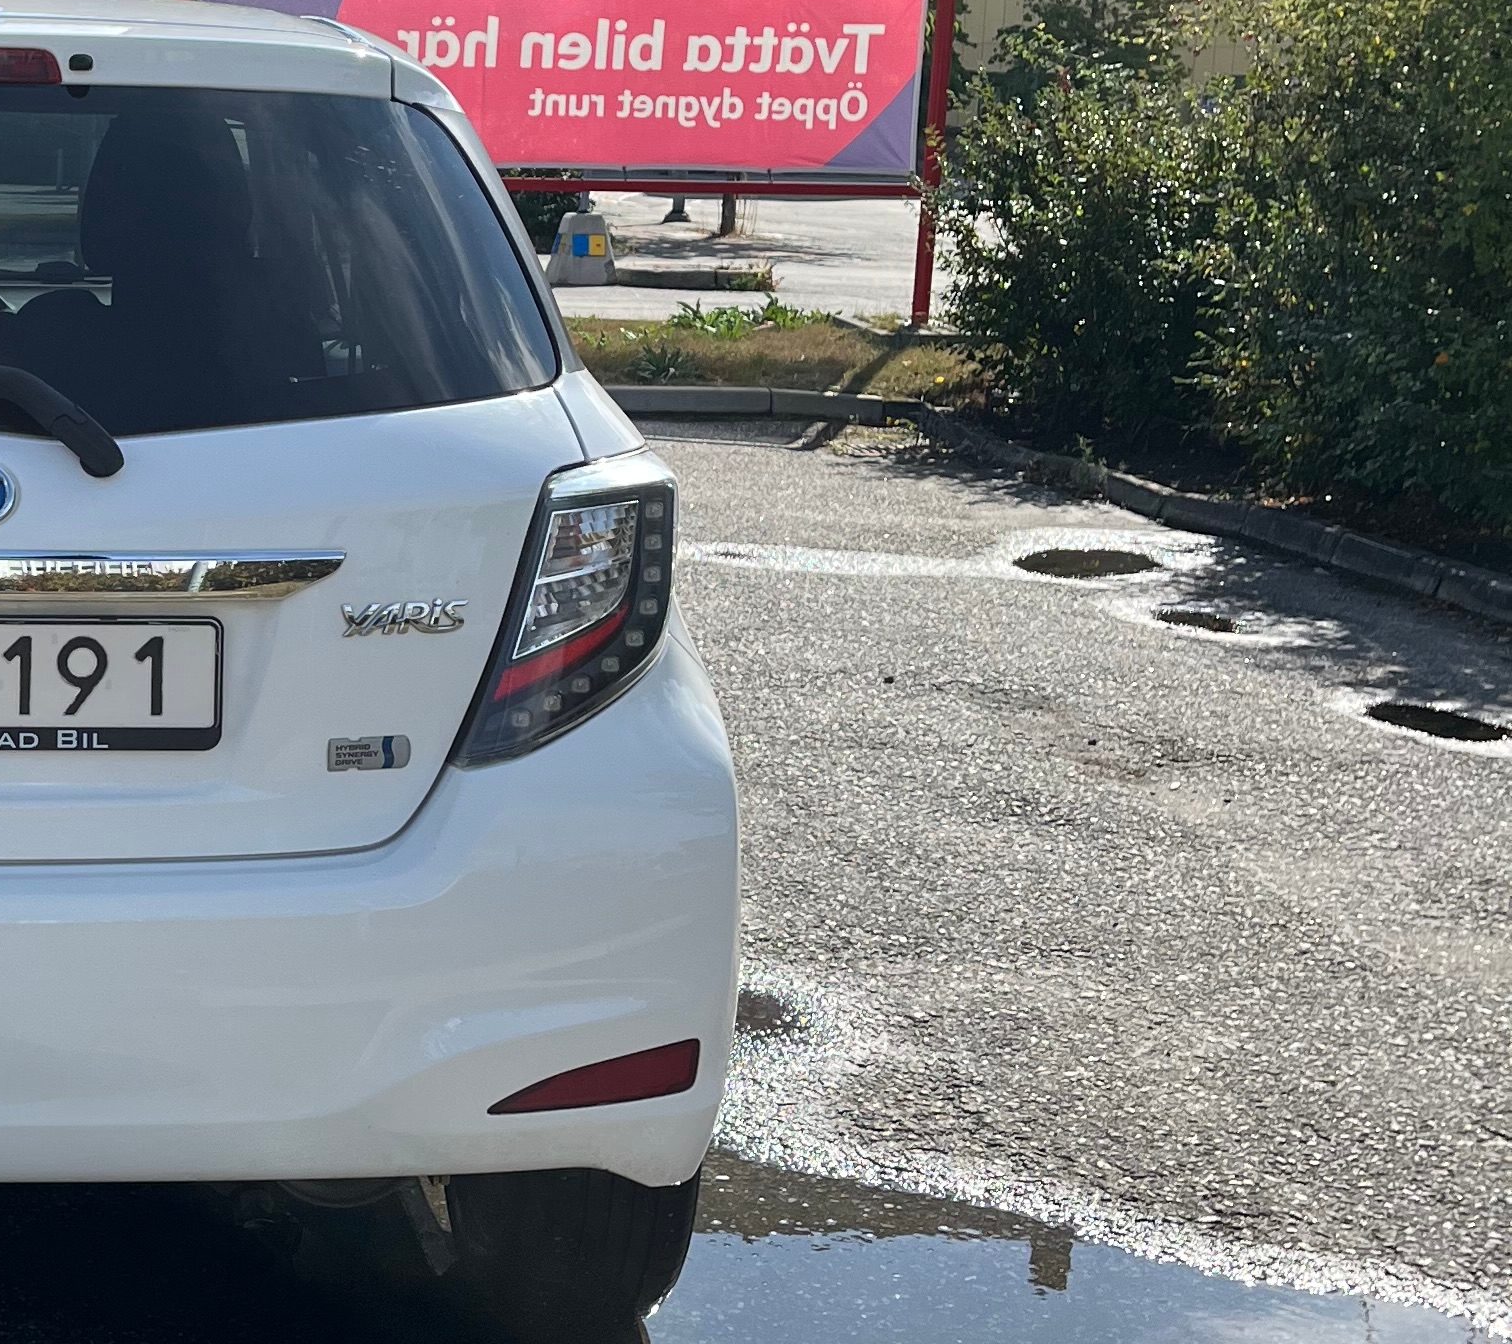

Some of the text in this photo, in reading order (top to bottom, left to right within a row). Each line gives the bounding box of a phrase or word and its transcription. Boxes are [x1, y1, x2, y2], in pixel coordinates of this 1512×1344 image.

[2, 635, 165, 716] 191
[335, 743, 371, 752] HYBRID
[335, 750, 379, 759] SYNERGY
[334, 758, 364, 766] DRIVE
